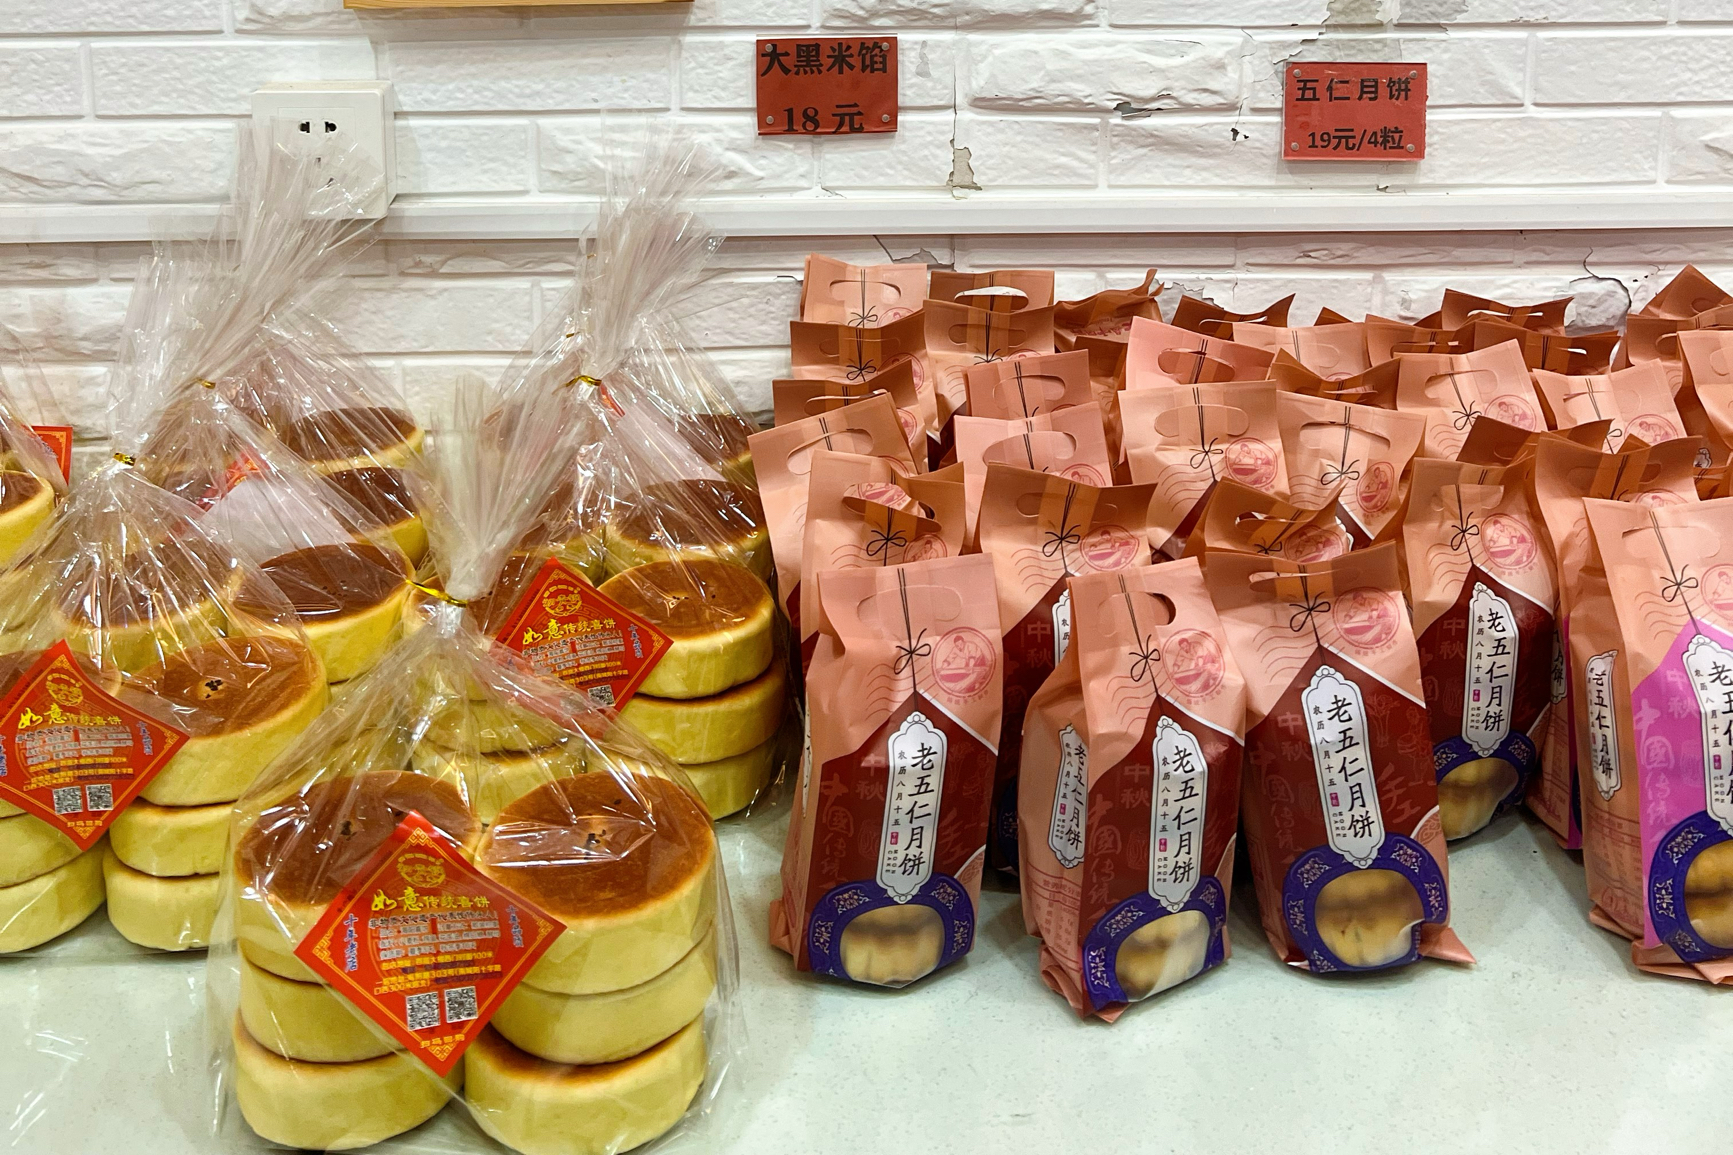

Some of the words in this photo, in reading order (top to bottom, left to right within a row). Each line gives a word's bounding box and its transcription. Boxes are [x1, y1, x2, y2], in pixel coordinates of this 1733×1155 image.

[761, 41, 888, 77] 大黑米馅
[1296, 77, 1411, 102] 五仁月饼
[783, 107, 820, 132] 18
[832, 103, 864, 134] 元
[1308, 126, 1404, 151] 19元/4粒
[1473, 615, 1485, 684] 农历八月十五
[1481, 608, 1510, 733] 老五仁月饼
[1312, 704, 1337, 787] 农历八月十五
[1327, 694, 1375, 839] 老五仁月饼
[891, 750, 907, 826] 农历八月十五
[899, 742, 938, 876] 老五仁月饼
[1159, 756, 1171, 833] 农历八月十五
[1169, 745, 1199, 884] 老五仁月饼
[371, 886, 490, 911] 如意传统喜饼
